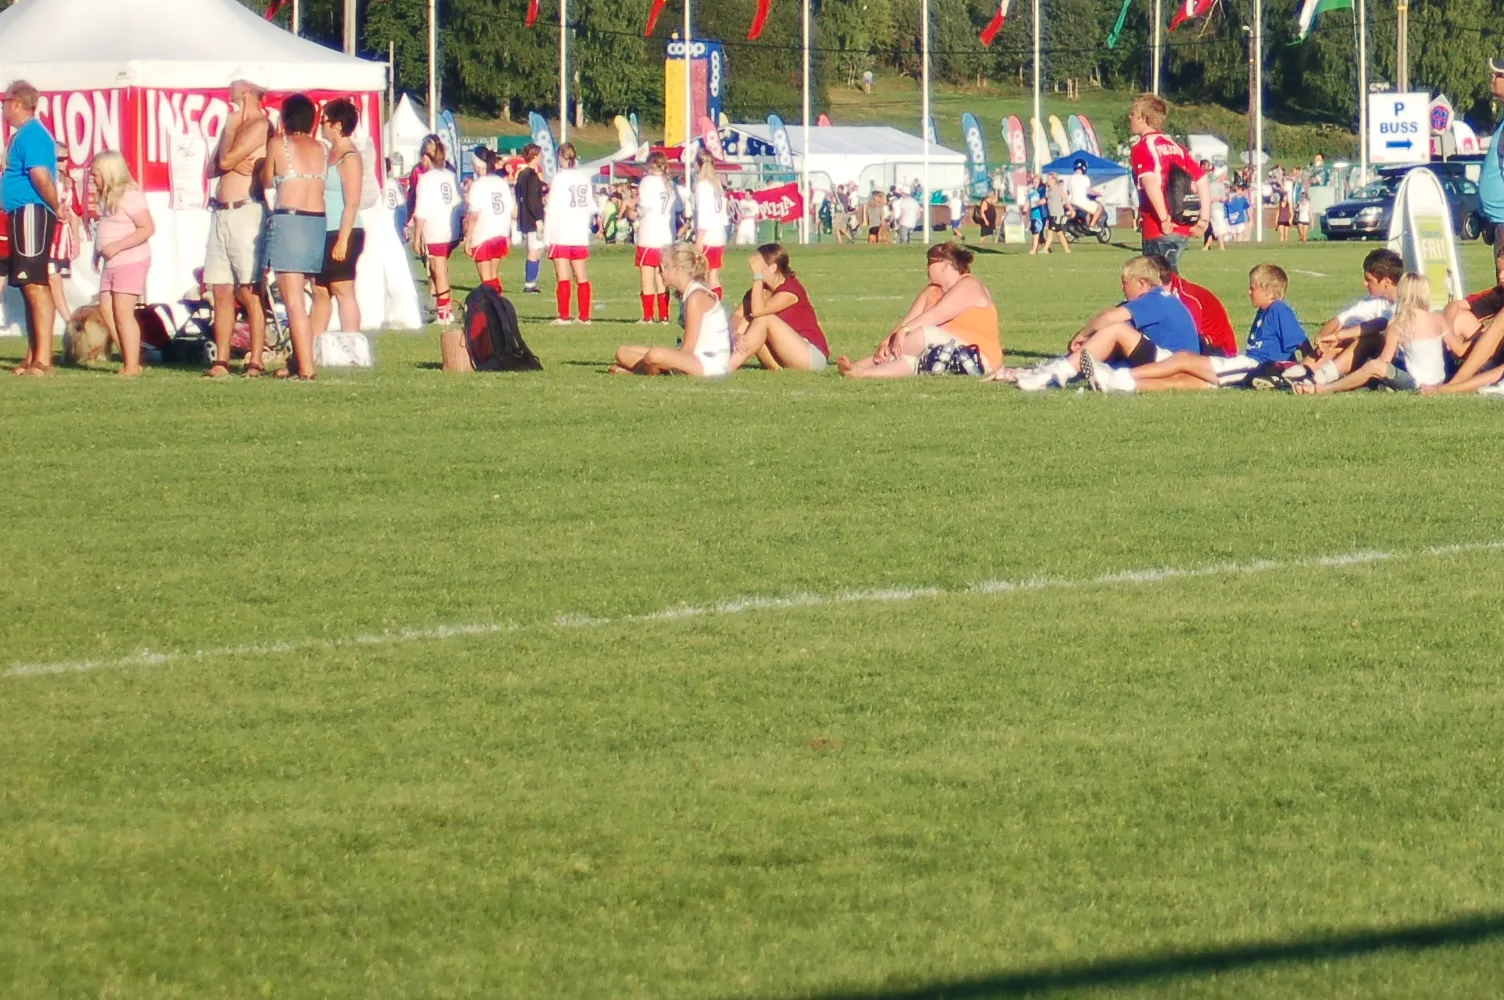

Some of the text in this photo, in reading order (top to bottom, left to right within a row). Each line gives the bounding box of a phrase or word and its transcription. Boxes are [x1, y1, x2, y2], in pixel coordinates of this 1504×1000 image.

[1393, 102, 1405, 116] P
[1379, 121, 1418, 134] BUSS
[440, 182, 453, 204] 9
[491, 192, 505, 215] 5
[569, 183, 589, 208] 19
